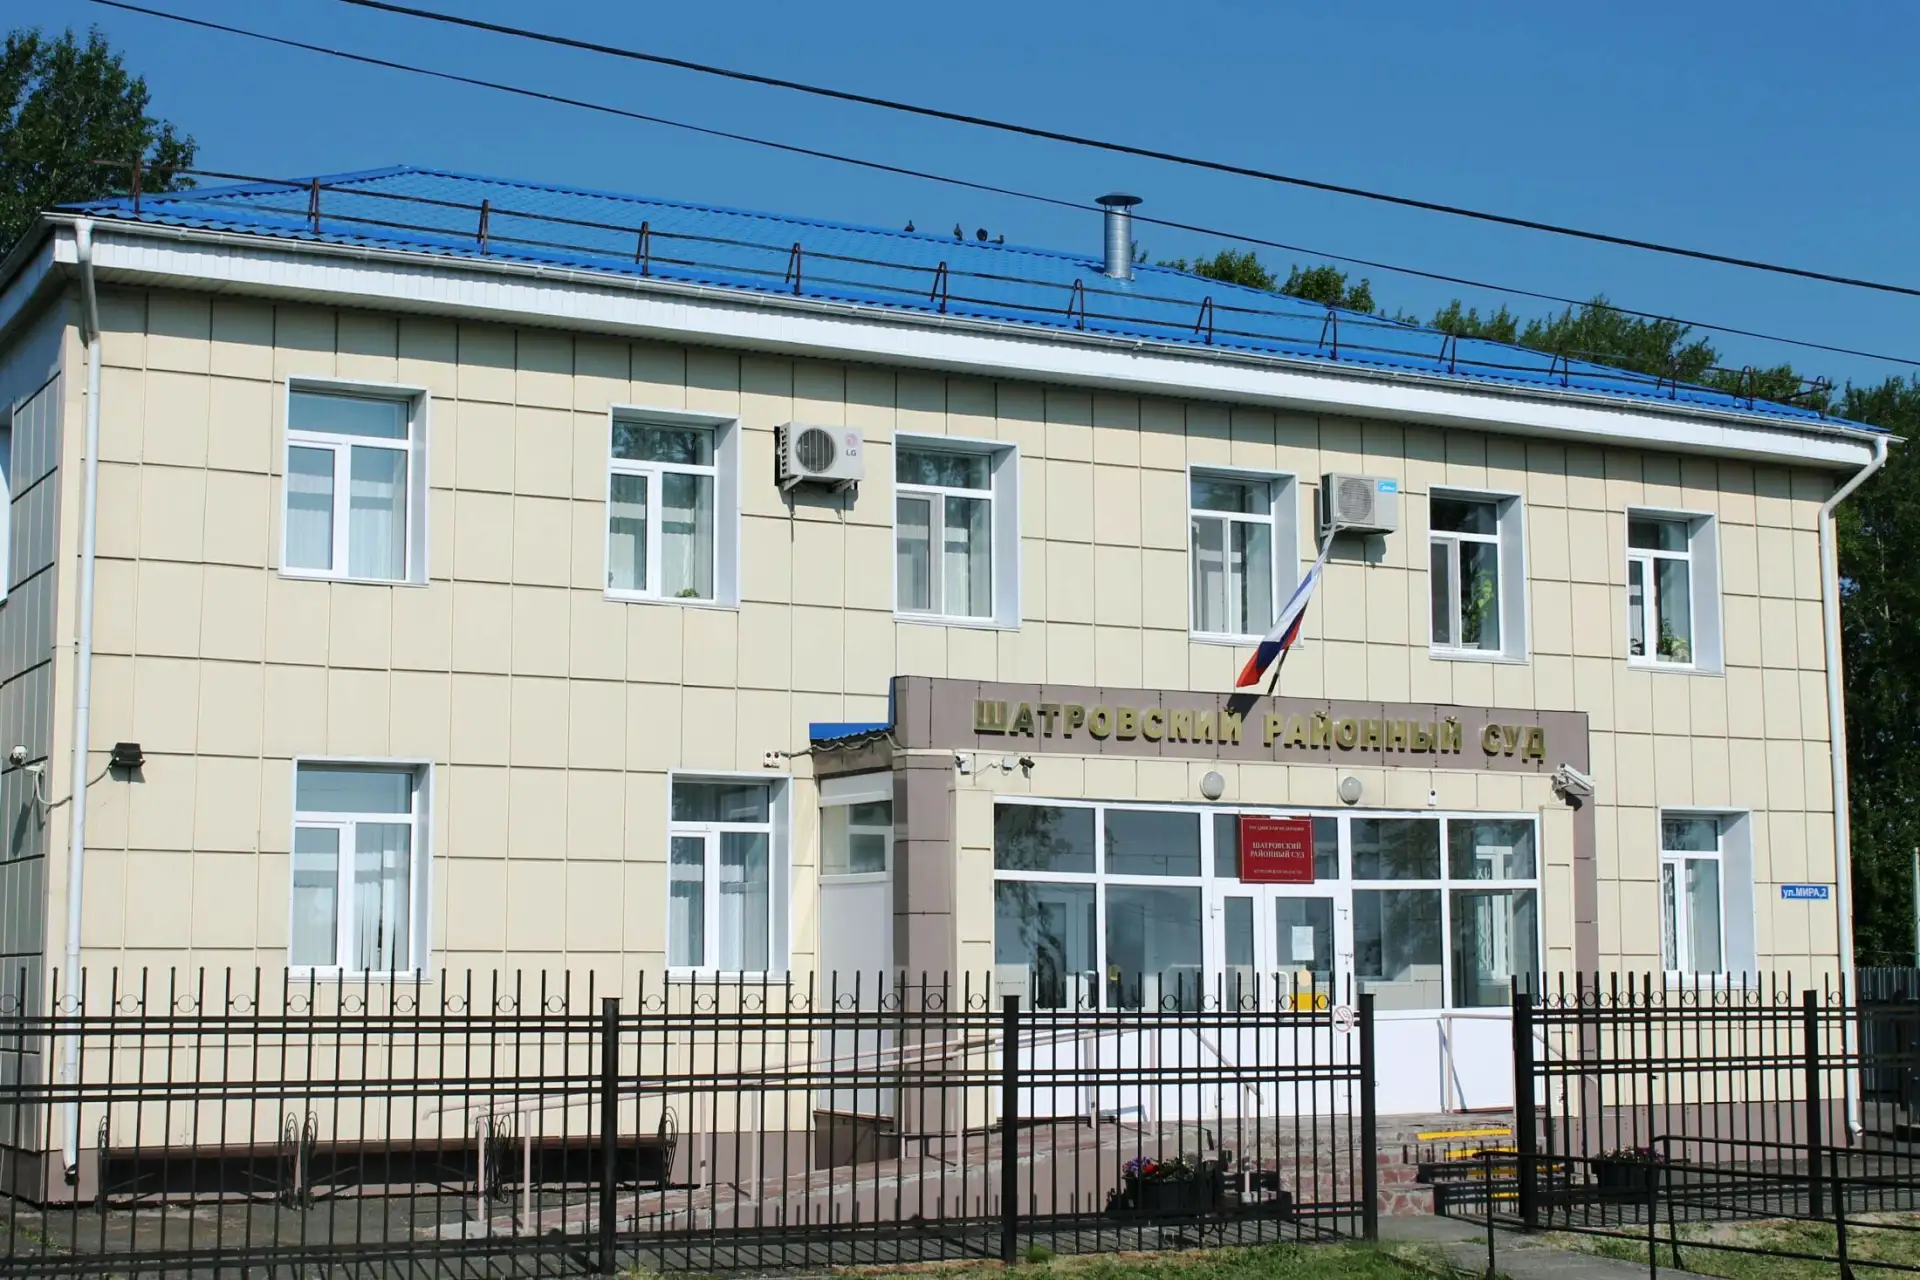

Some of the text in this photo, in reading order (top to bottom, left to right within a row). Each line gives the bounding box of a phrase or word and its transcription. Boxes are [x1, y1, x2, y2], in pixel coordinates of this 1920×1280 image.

[974, 698, 1546, 763] ШАТРОВСКИЙ РАЙОННЫЙ СУД
[1252, 841, 1301, 849] ШАТРОВСКИЙ
[1250, 849, 1304, 859] РАЙОННЫЙ СУД
